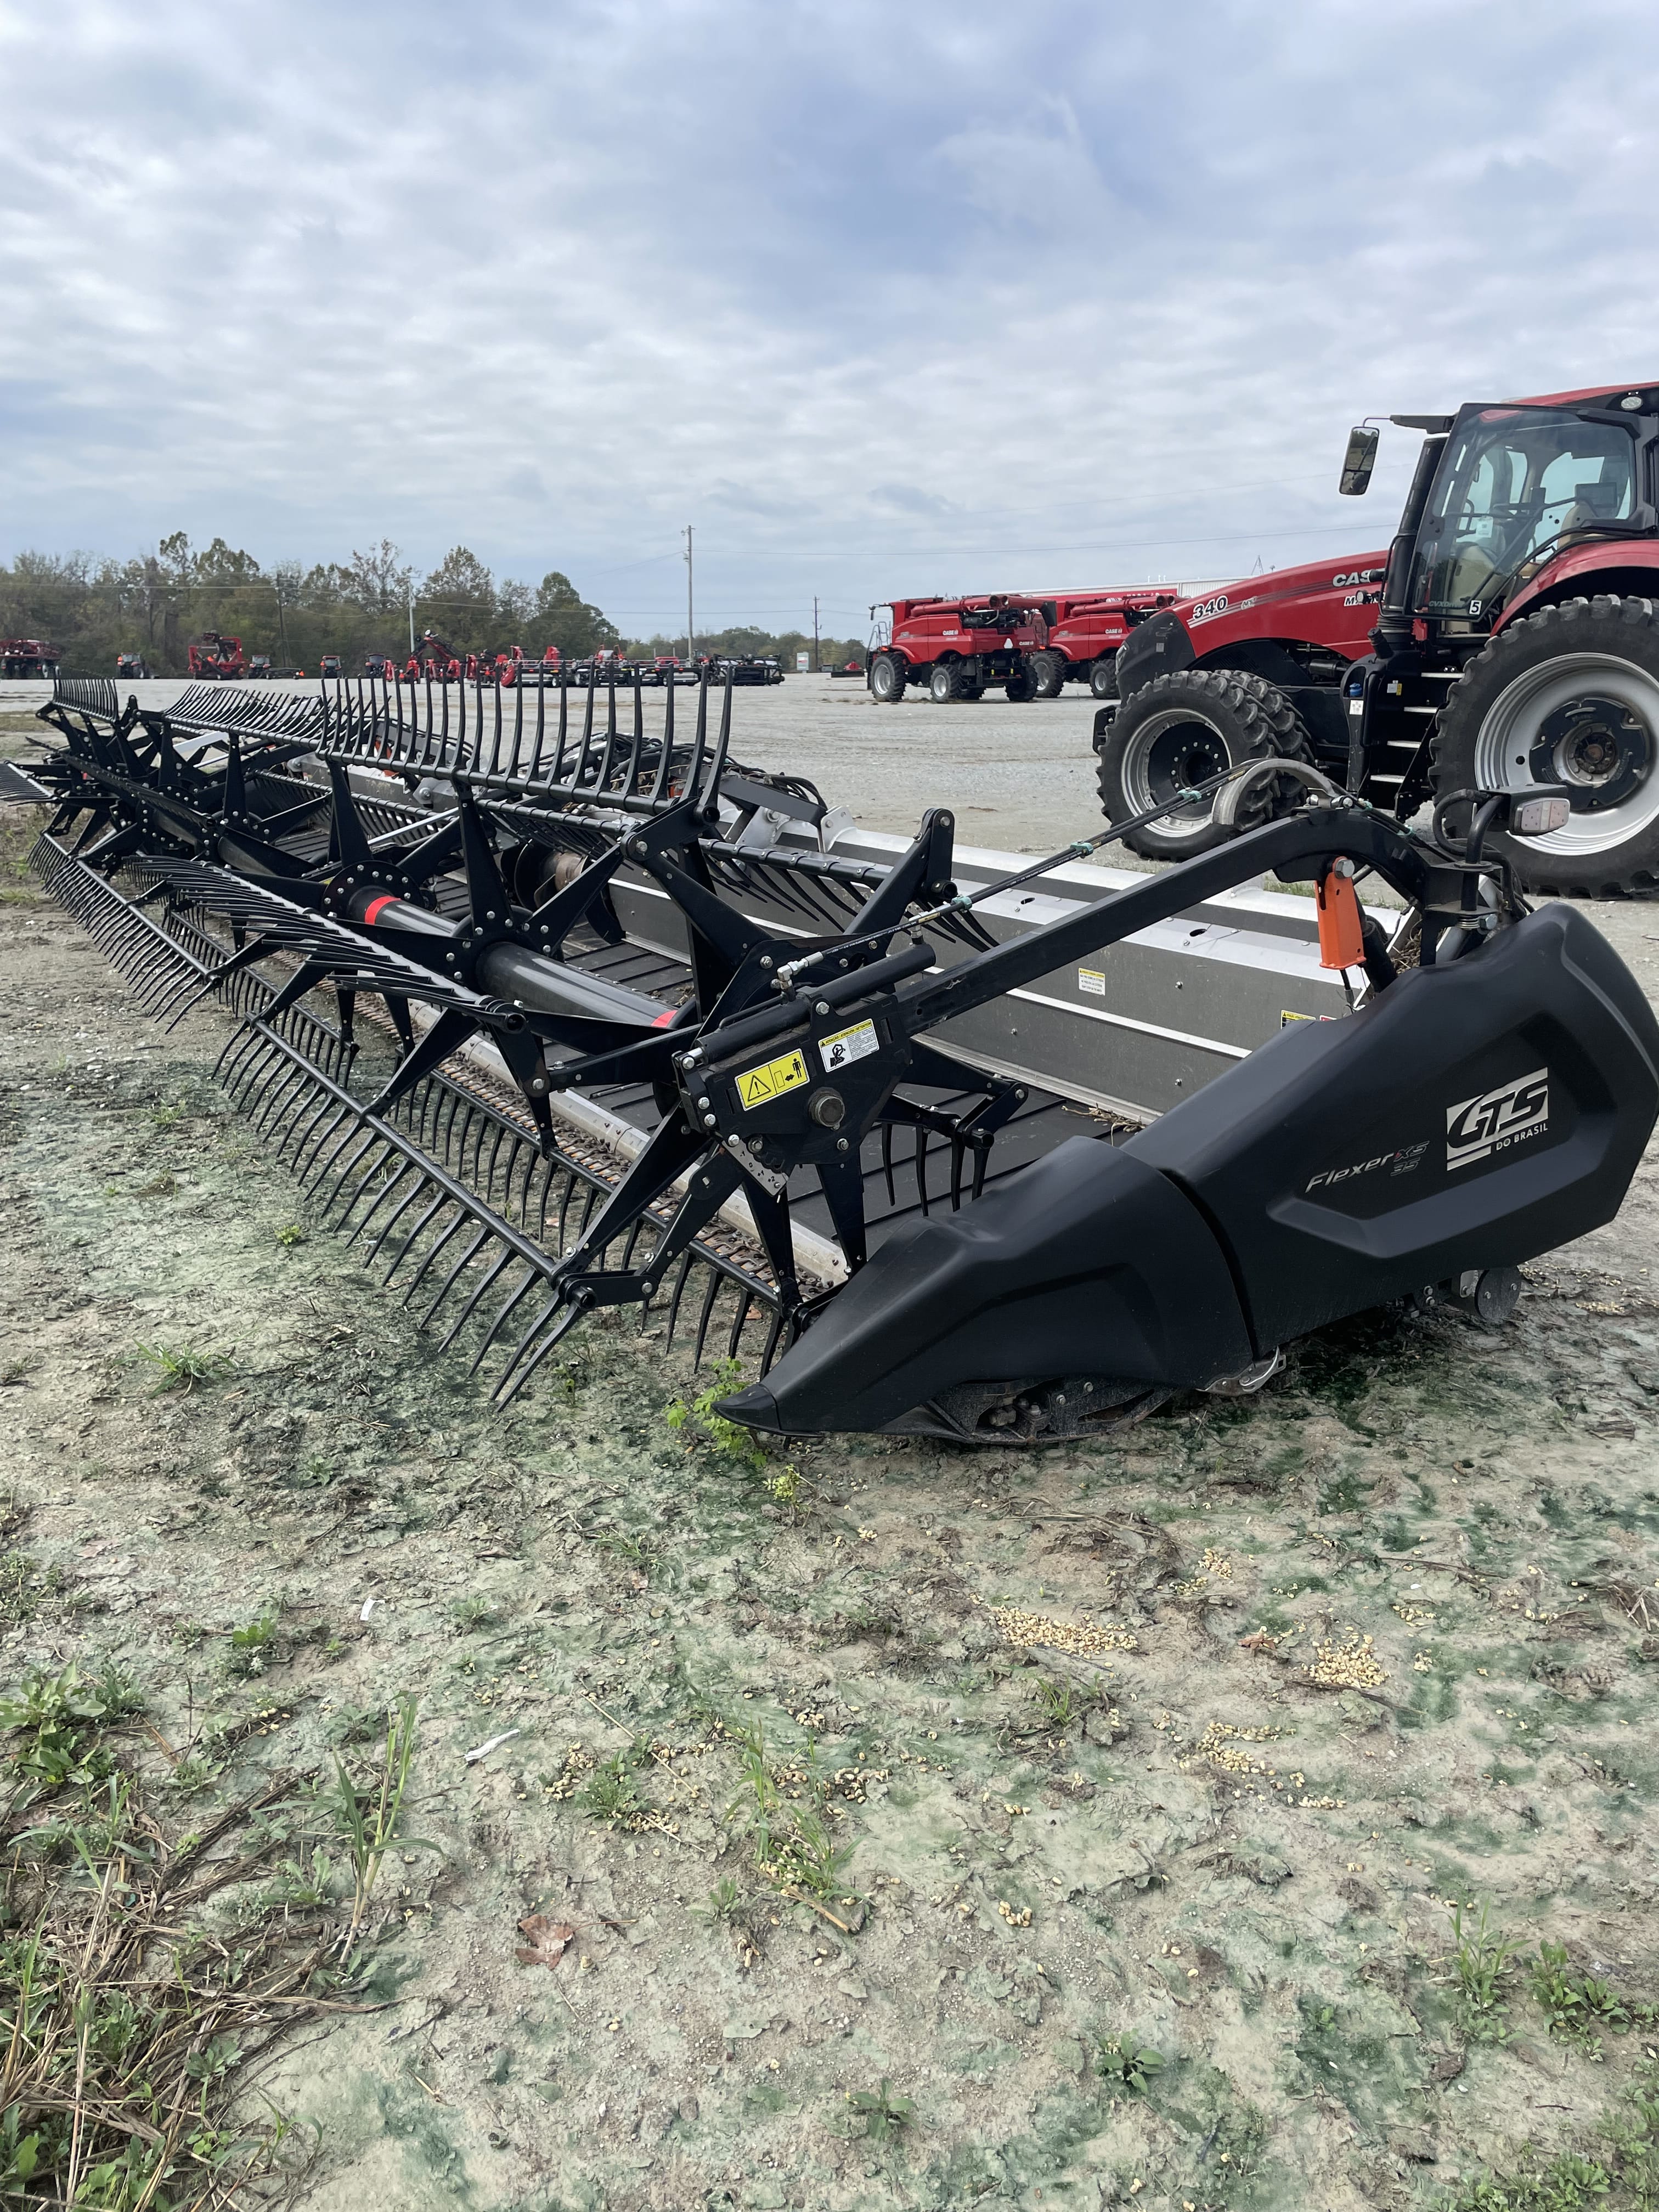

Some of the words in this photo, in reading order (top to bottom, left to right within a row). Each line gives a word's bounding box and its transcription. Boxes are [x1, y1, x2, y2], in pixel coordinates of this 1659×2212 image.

[1193, 595, 1228, 620] 340
[1471, 602, 1480, 613] 5
[1448, 1077, 1548, 1148] GTS
[1496, 1138, 1511, 1150] DO
[1514, 1123, 1548, 1143] BRASIL
[1305, 1153, 1395, 1194] Flexer
[1390, 1156, 1421, 1177] 35
